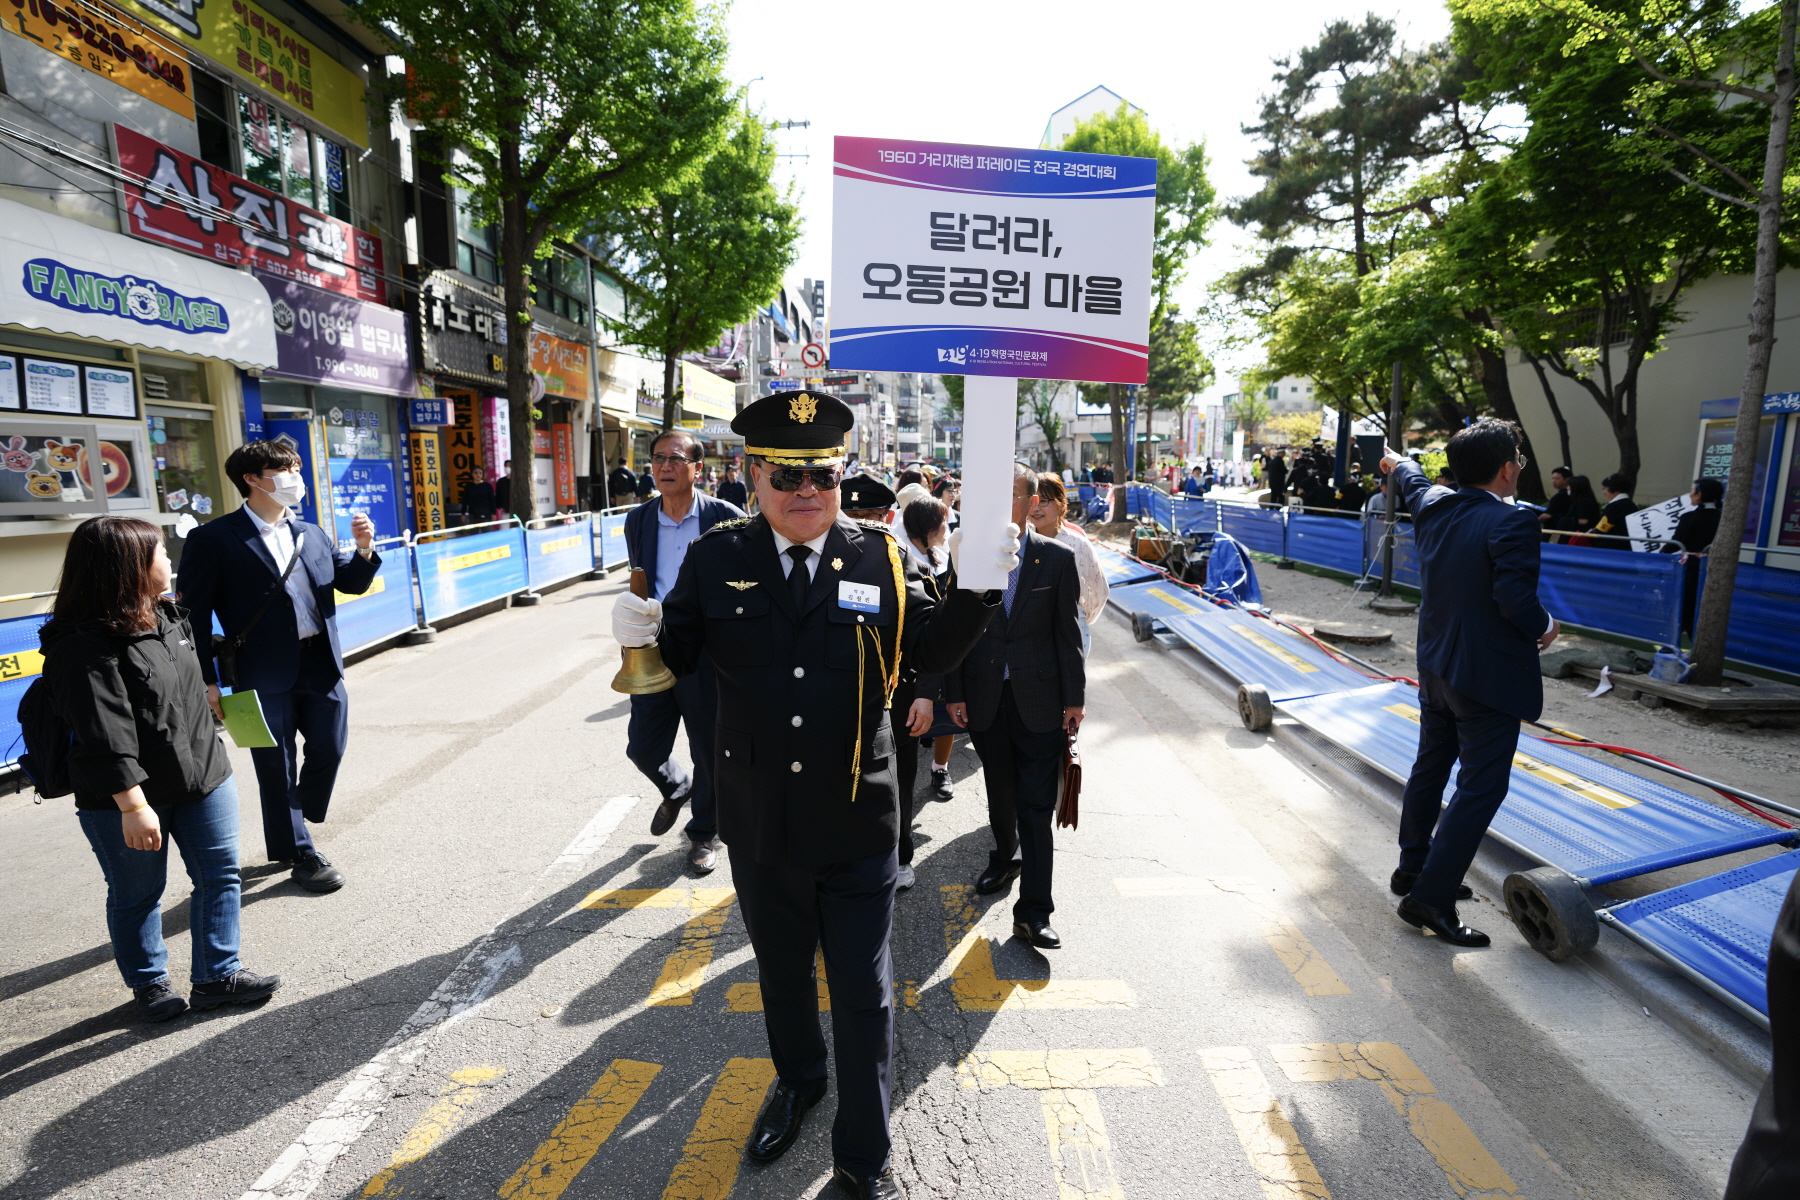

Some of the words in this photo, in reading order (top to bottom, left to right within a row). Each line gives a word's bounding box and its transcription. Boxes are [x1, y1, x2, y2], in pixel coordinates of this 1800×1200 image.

[52, 33, 82, 61] 2층
[88, 52, 117, 77] 입구
[233, 1, 311, 68] 이미지사진
[234, 22, 312, 89] 가족사진
[236, 47, 314, 110] 프로필사진
[248, 98, 272, 159] 여권
[878, 150, 916, 165] 1960
[919, 152, 974, 170] 거리재현
[976, 155, 1031, 175] 퍼레이드
[1033, 160, 1061, 177] 전국
[1063, 163, 1117, 180] 경연대회
[142, 148, 350, 279] 사진관
[930, 211, 1063, 258] 달려라,
[214, 242, 242, 263] 입구
[29, 264, 131, 316] FANCY
[158, 292, 229, 331] BAGEL
[863, 262, 1031, 310] 오동공원
[1044, 272, 1123, 316] 마을
[300, 308, 355, 349] 이영열
[360, 322, 408, 361] 법무사
[315, 356, 379, 380] T.994-3040
[552, 345, 585, 375] 사진관
[249, 422, 263, 432] 고소
[344, 408, 379, 428] 이영열
[416, 402, 441, 413] 이영열
[416, 412, 441, 422] 법무사
[449, 393, 477, 450] 변호사
[344, 426, 382, 445] 법무사
[352, 469, 369, 481] 민사
[412, 438, 425, 488] 변호사
[424, 438, 439, 488] 변호사
[453, 452, 475, 504] 이승
[1702, 467, 1731, 477] 2024
